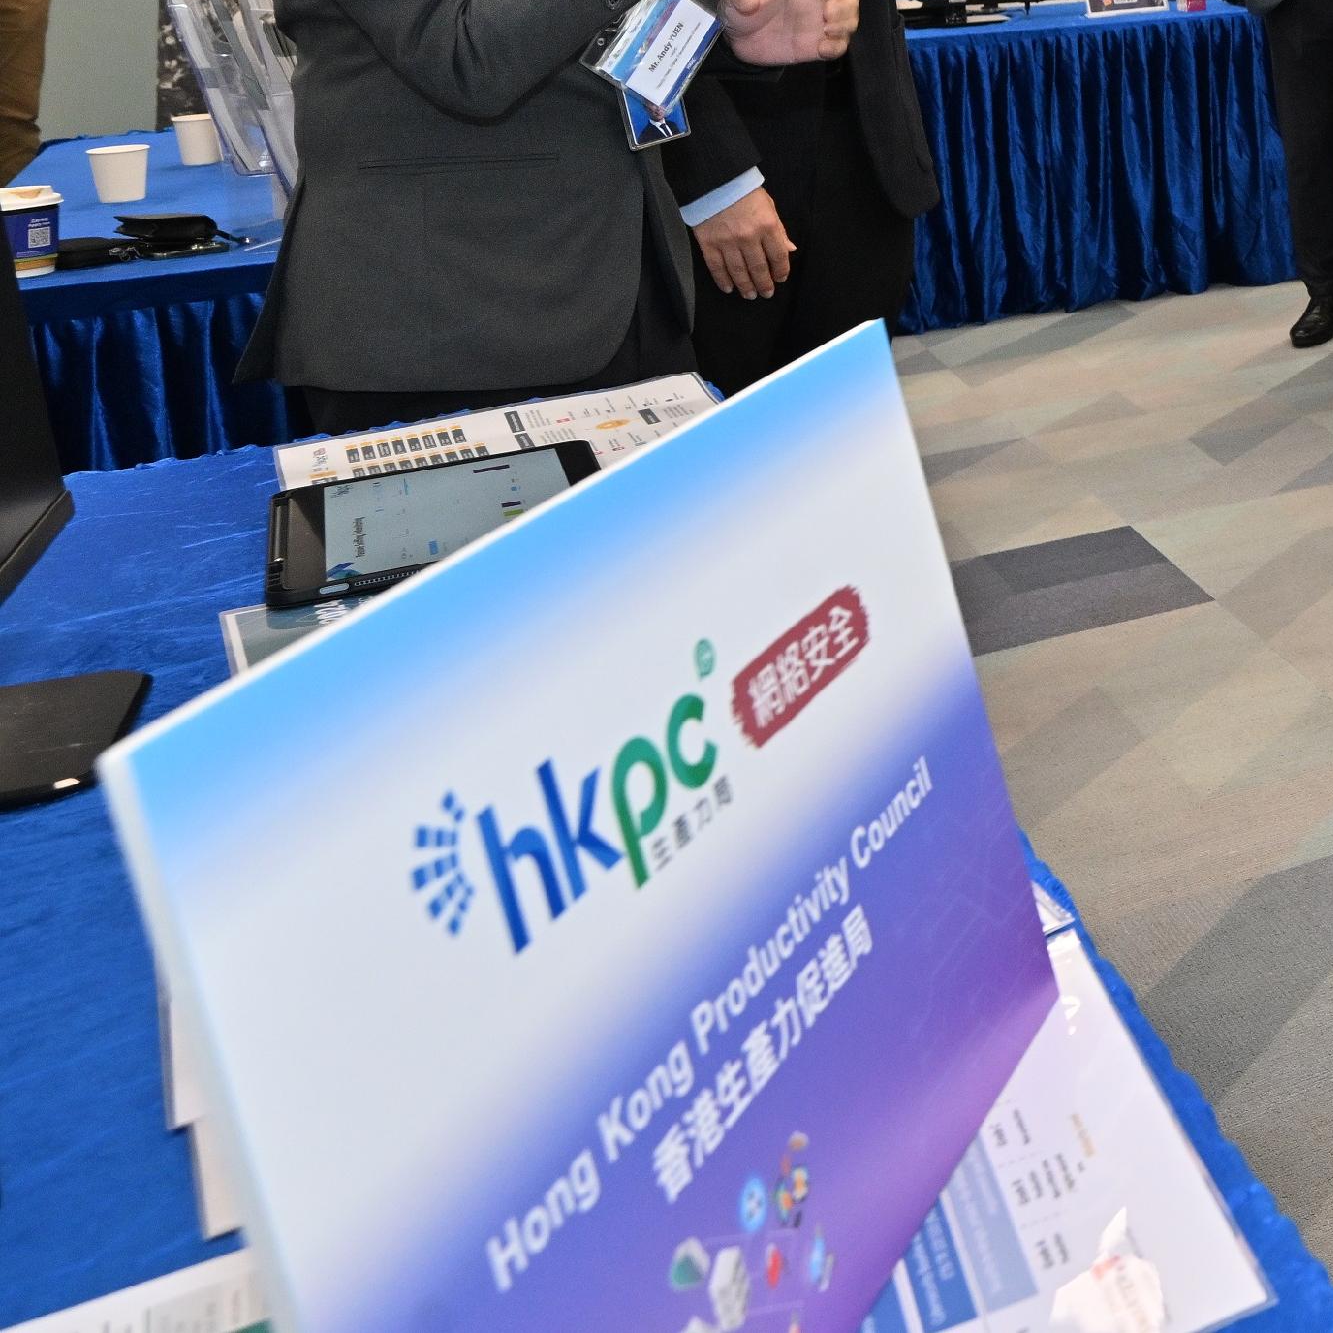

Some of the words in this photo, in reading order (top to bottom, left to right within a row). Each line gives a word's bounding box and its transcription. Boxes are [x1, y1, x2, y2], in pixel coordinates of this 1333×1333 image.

[649, 57, 660, 72] Mr.
[658, 41, 673, 63] Andy
[746, 603, 861, 729] 網絡安全
[474, 693, 718, 955] hkpc
[649, 774, 735, 869] 生產力局
[484, 1149, 602, 1292] Hong
[597, 1041, 694, 1164] Kong
[691, 856, 852, 1050] Productivity
[850, 756, 933, 871] Council
[651, 906, 874, 1204] 香港生產力促進局
